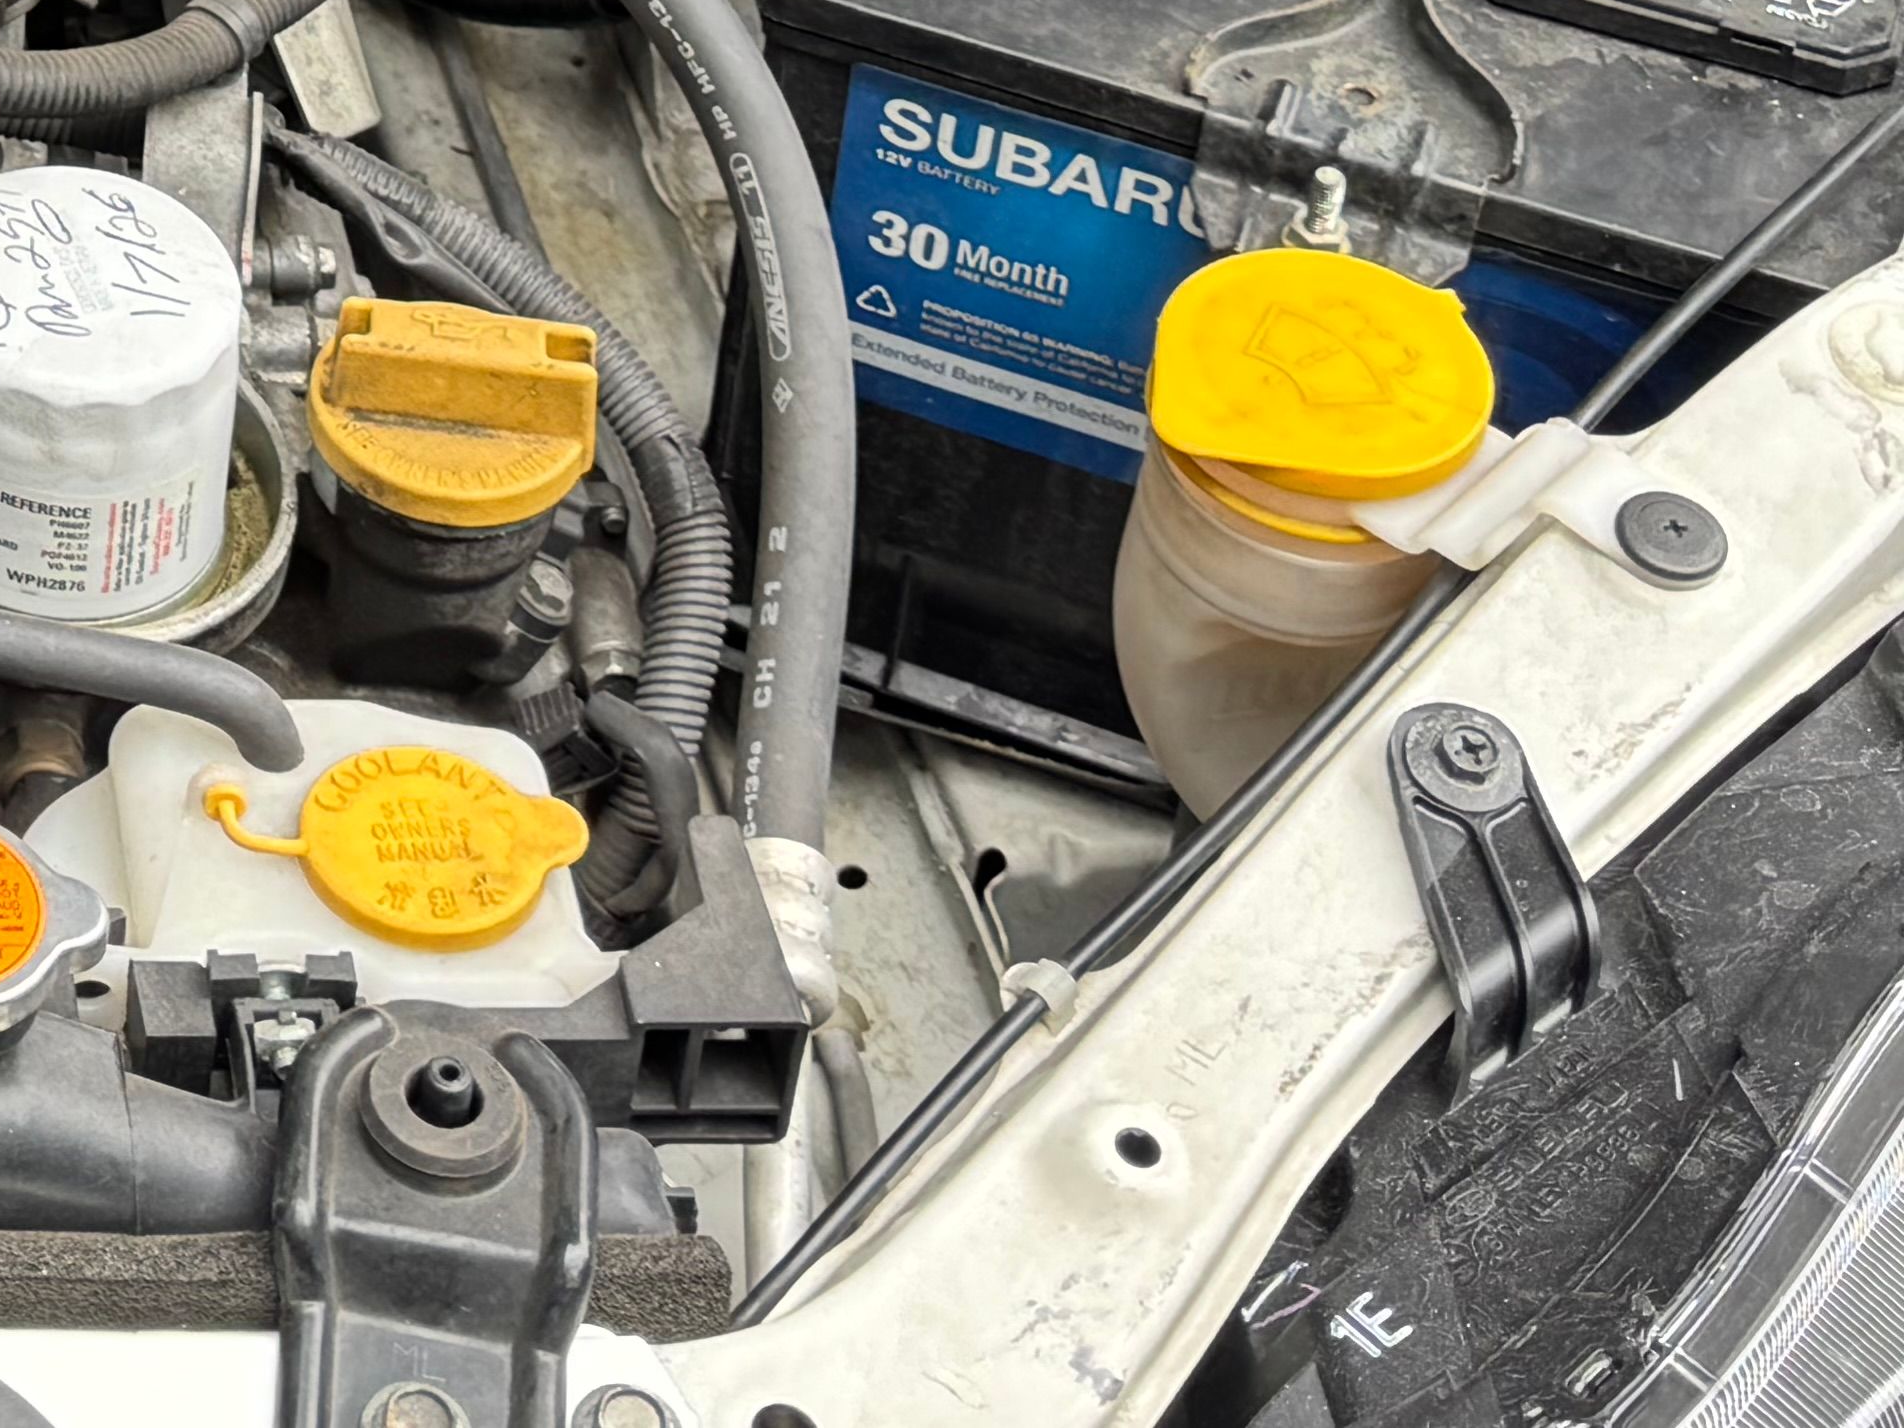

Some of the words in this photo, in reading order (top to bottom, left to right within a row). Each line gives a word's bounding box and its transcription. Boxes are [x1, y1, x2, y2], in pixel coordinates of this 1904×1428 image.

[711, 104, 737, 141] HP
[874, 147, 913, 169] 12V
[917, 160, 1001, 197] BATTERY
[82, 188, 191, 317] 1/7/26
[867, 210, 950, 271] 30
[956, 239, 1071, 298] Month
[852, 331, 945, 376] Extended
[951, 365, 1028, 402] Battery
[1034, 389, 1139, 436] Protection
[0, 491, 91, 520] REFERENCE
[6, 568, 86, 592] WPH2876
[314, 750, 507, 814] COOLANT
